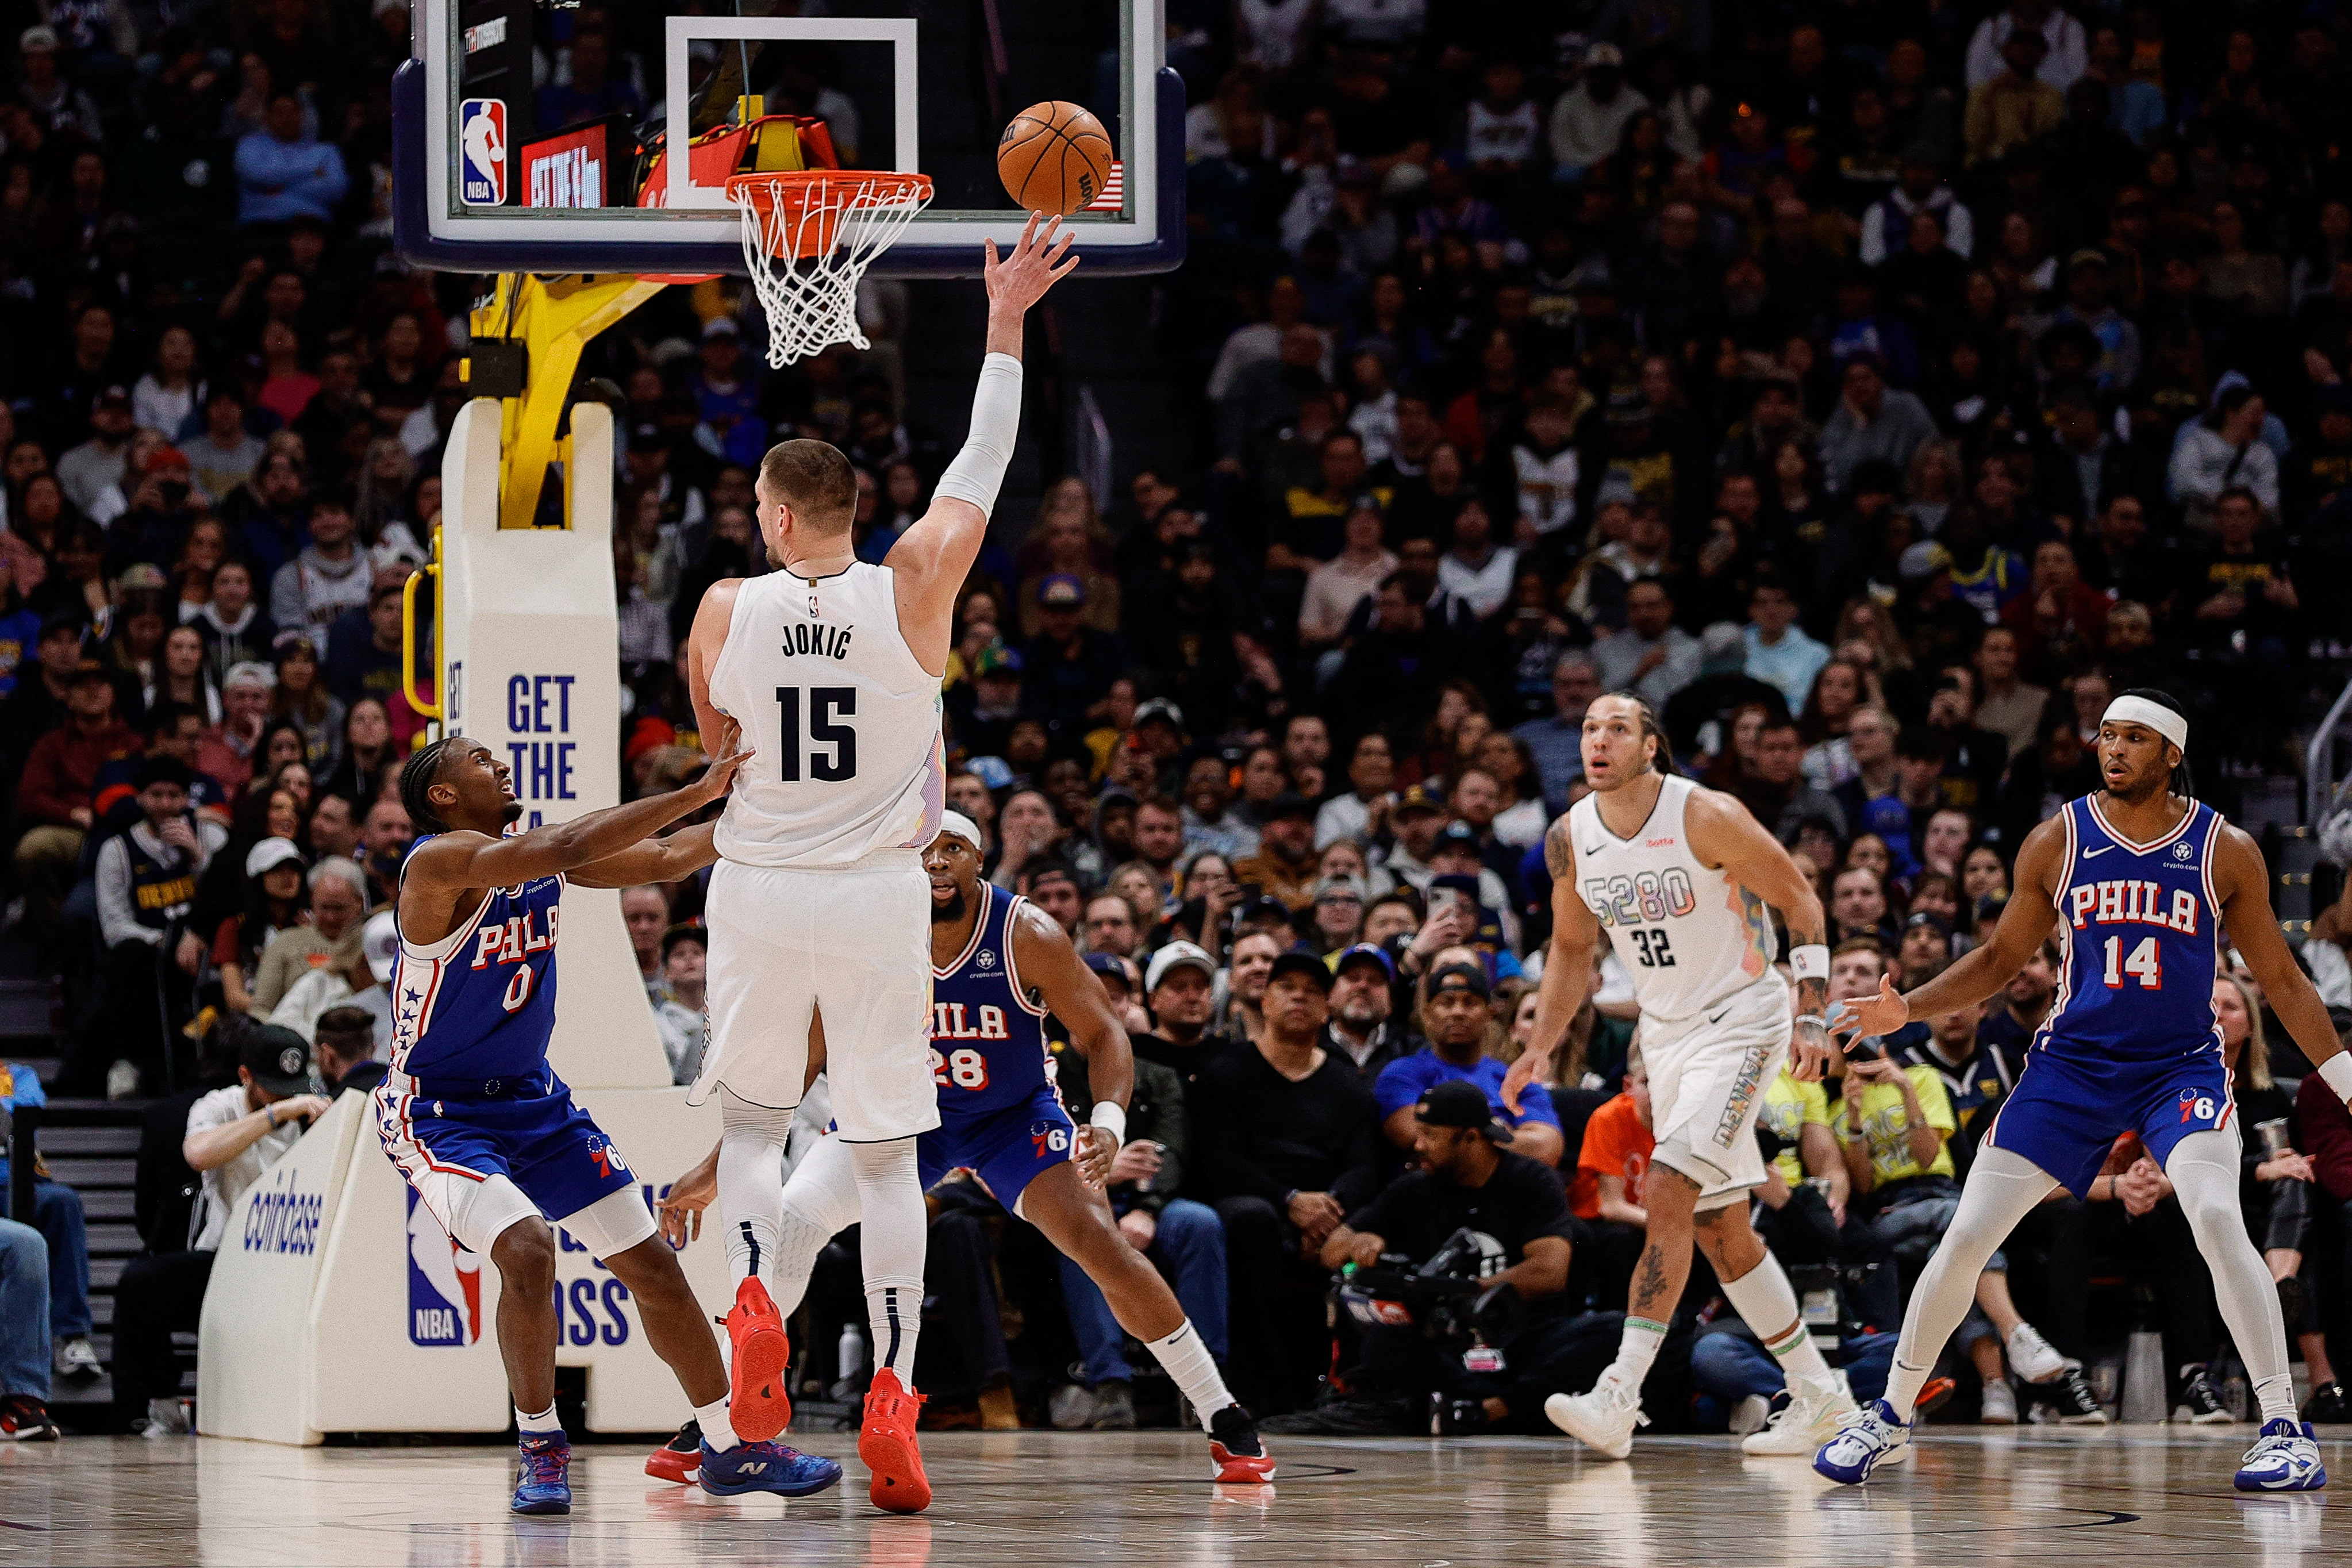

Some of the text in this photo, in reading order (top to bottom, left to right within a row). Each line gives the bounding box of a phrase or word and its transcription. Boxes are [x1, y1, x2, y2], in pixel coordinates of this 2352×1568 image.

[467, 181, 490, 199] NBA
[782, 623, 854, 660] JOKIĆ
[508, 675, 575, 733] GET
[775, 686, 856, 782] 15
[508, 743, 576, 799] THE
[527, 878, 555, 894] crypto.com
[1585, 867, 1695, 928] 5280
[2070, 879, 2199, 936] PHILA
[1631, 929, 1675, 967] 32
[2103, 935, 2162, 990] 14
[502, 963, 535, 1014] 0
[930, 1002, 1012, 1041] ILA
[928, 1047, 990, 1092] 28
[2180, 1096, 2215, 1124] 76
[590, 1144, 627, 1178] 76
[1031, 1129, 1068, 1159] 76
[244, 1167, 322, 1258] coinbase
[415, 1308, 456, 1340] NBA
